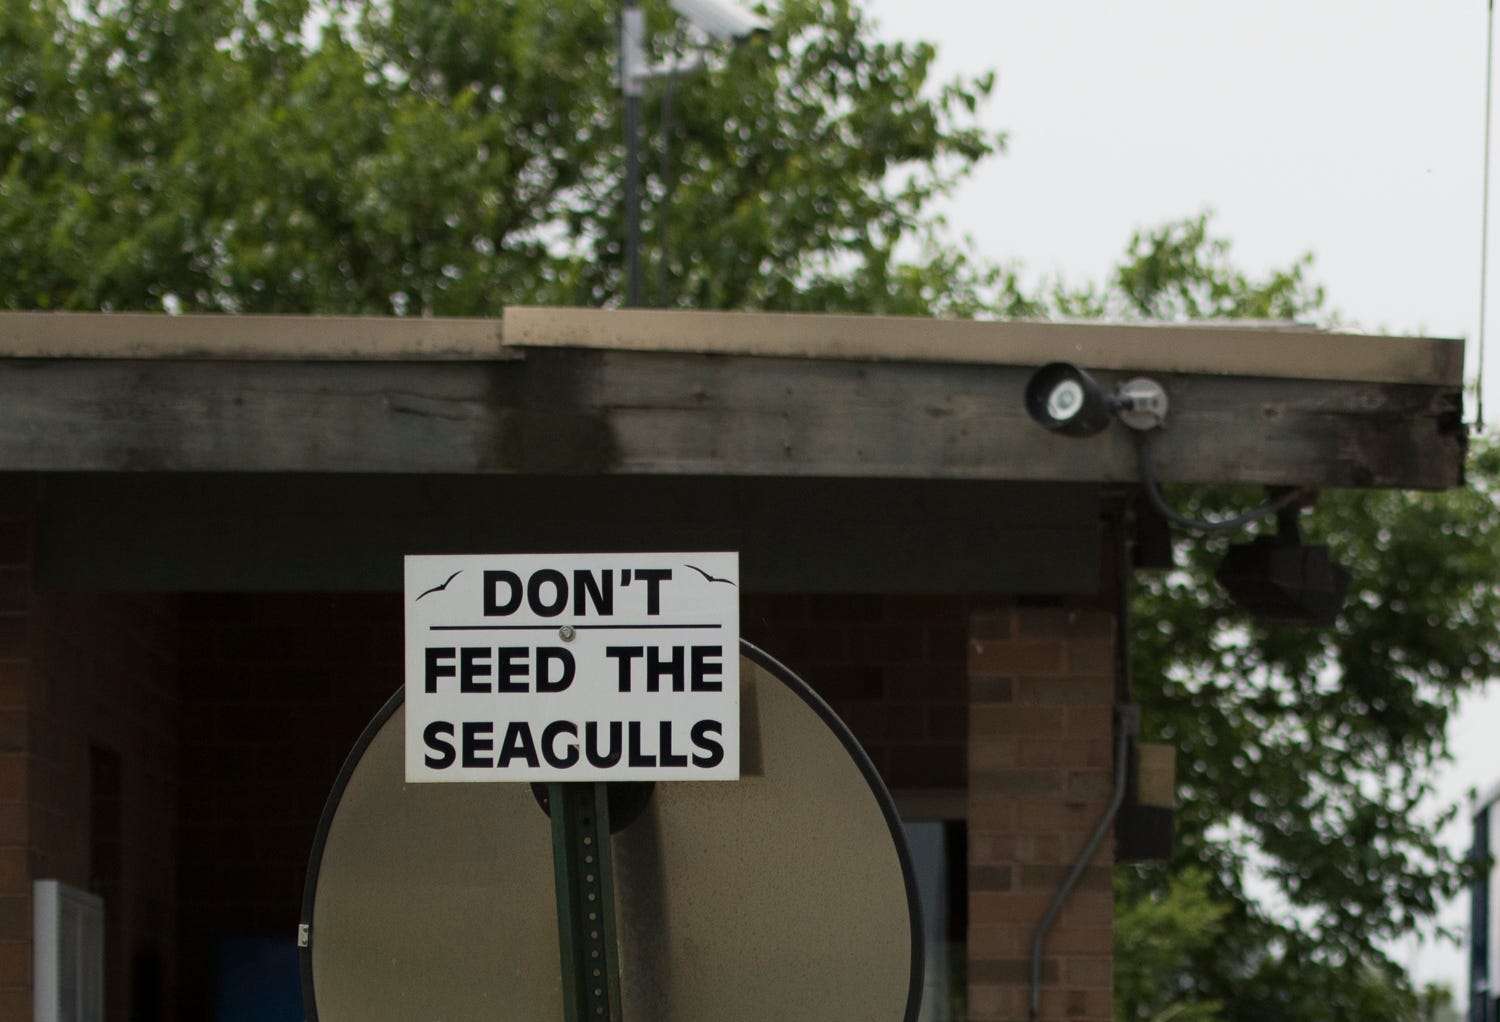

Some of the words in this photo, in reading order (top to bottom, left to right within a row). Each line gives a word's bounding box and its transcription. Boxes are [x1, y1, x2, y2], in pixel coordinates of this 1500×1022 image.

[484, 569, 672, 617] DON'T
[425, 647, 575, 693] FEED
[606, 646, 722, 692] THE
[423, 720, 725, 769] SEAGULLS
